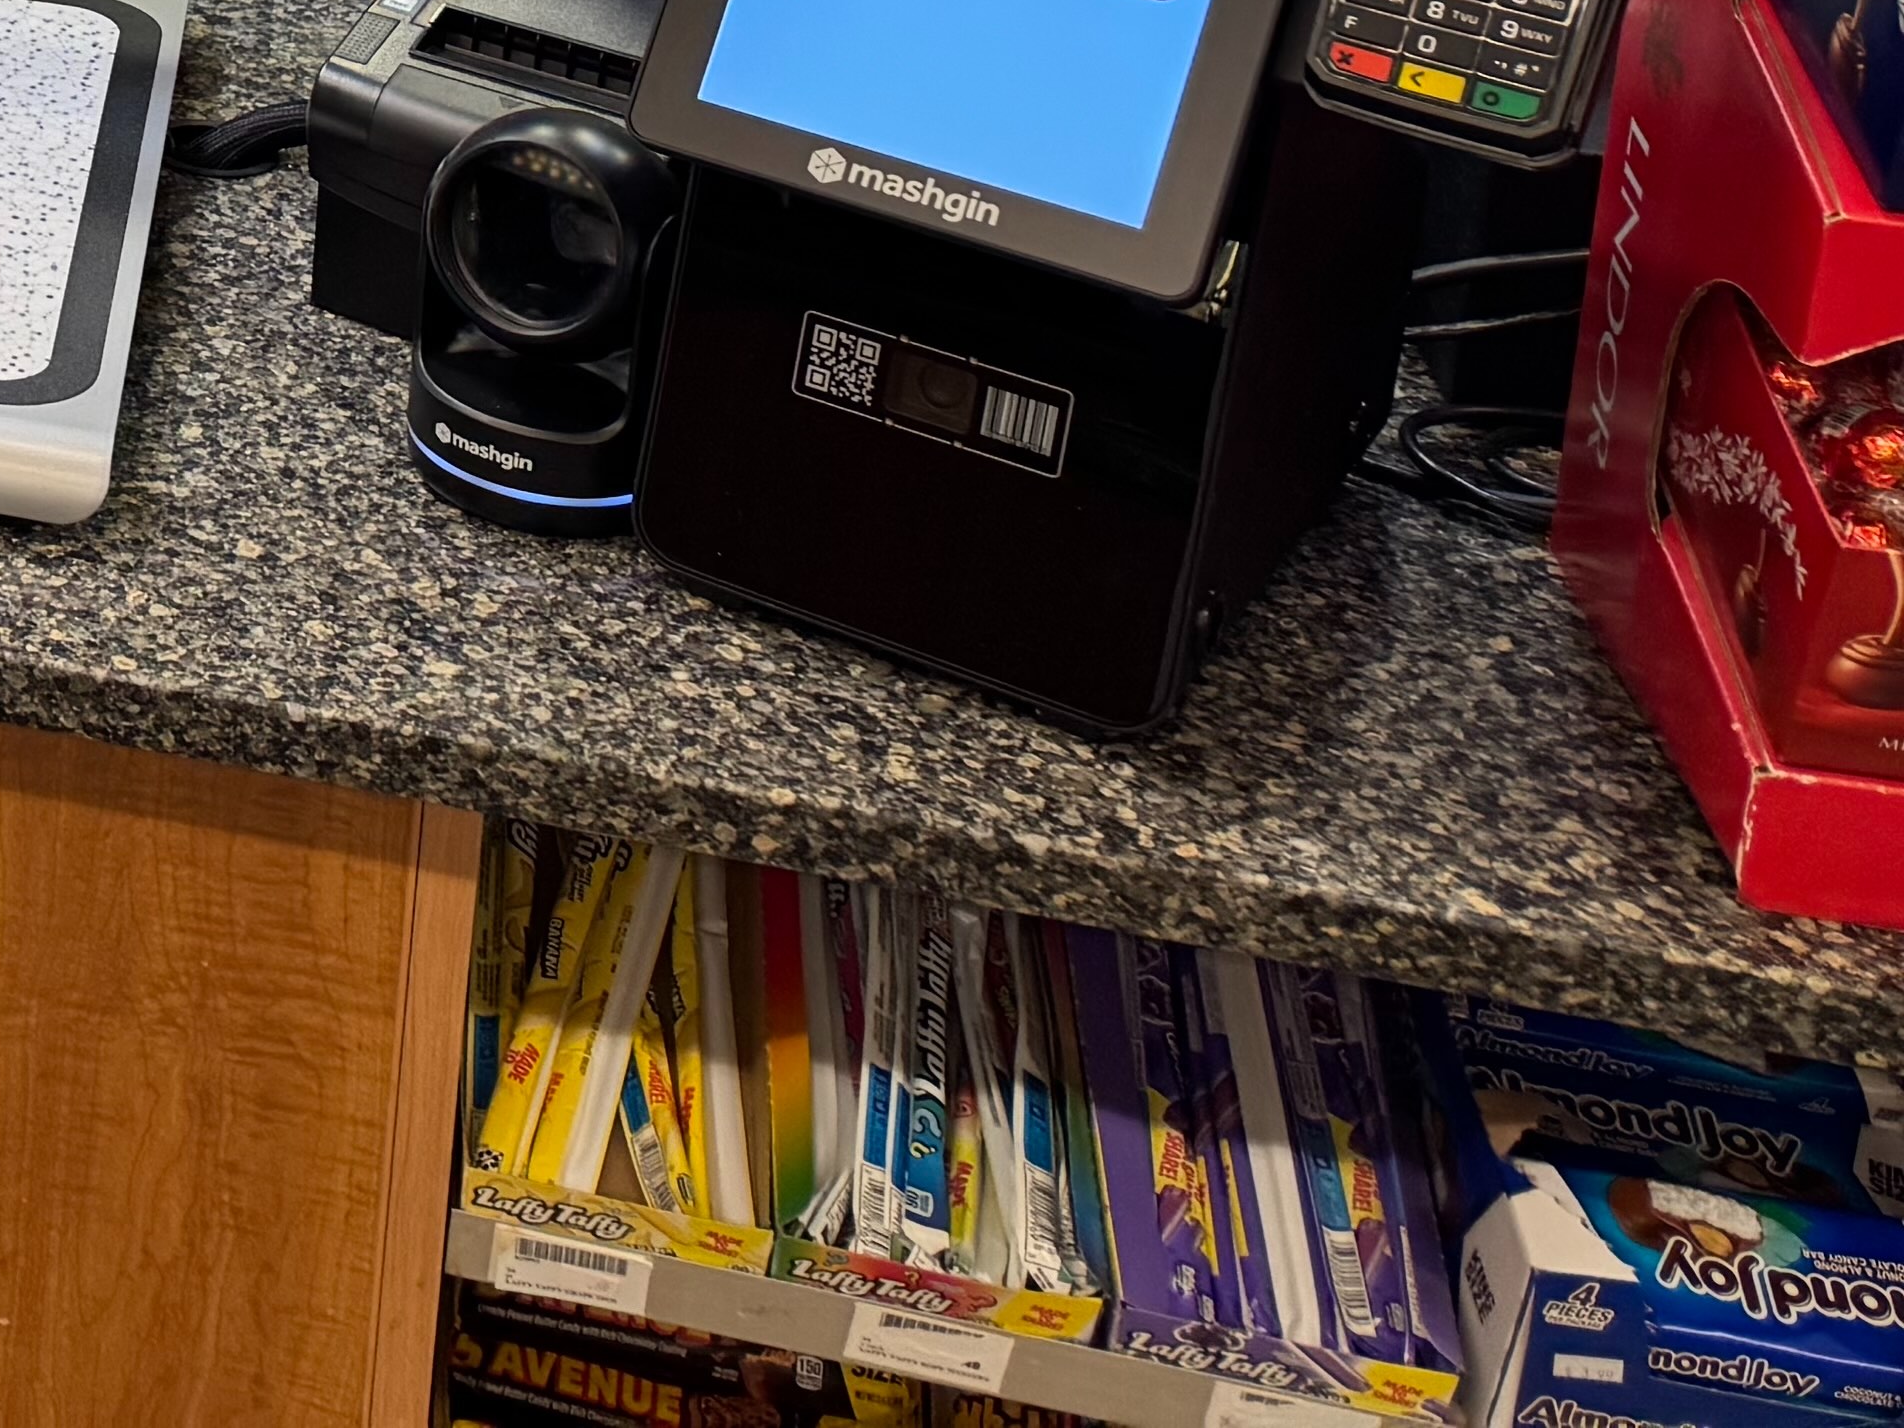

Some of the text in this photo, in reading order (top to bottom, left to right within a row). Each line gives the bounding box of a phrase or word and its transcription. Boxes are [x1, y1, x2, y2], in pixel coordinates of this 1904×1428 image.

[847, 155, 1001, 228] mashgin
[452, 429, 533, 473] mashgin
[473, 1186, 634, 1238] Laffy Taffy
[792, 1258, 951, 1314] Laffy Taffy
[1543, 1299, 1615, 1323] PIECES
[490, 1346, 683, 1424] AVENUE
